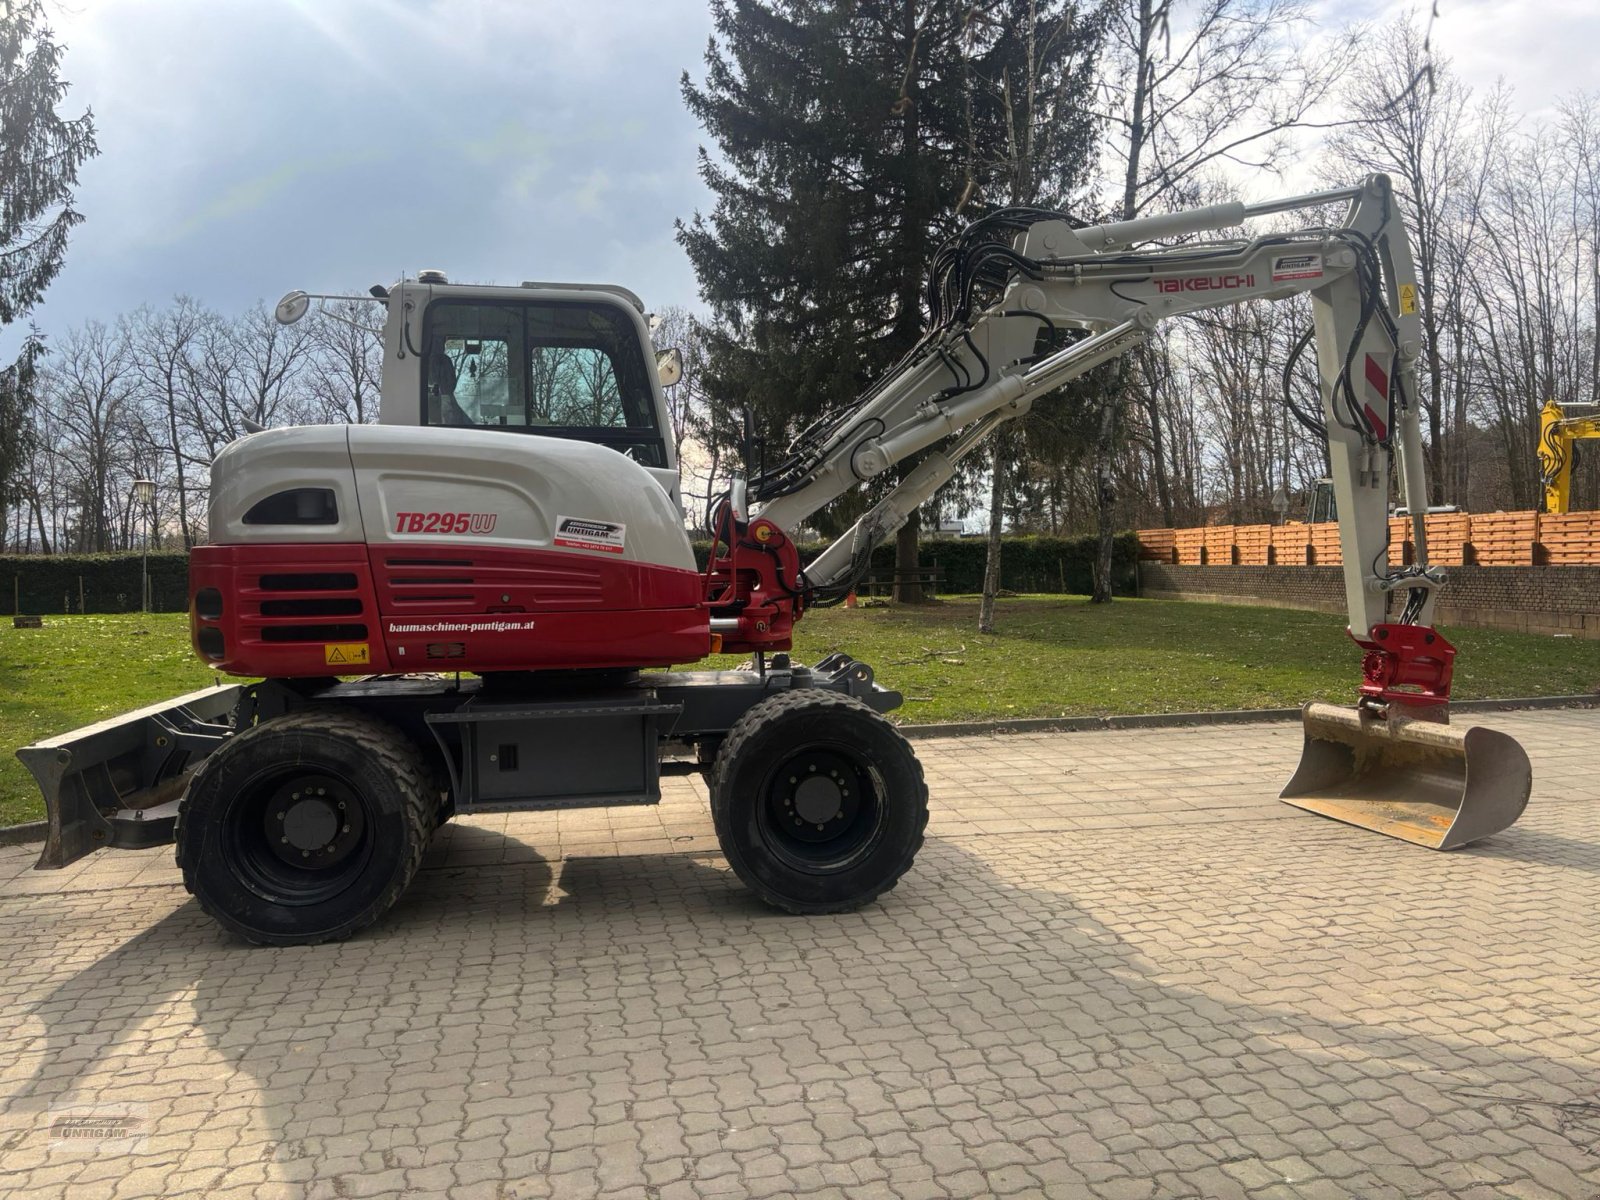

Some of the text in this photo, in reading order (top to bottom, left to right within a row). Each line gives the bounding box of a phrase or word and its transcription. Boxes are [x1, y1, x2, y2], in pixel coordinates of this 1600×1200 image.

[1153, 274, 1255, 293] TAKEUCHI
[396, 512, 497, 534] TB295W
[389, 621, 535, 633] baumaschinen-puntigam.at
